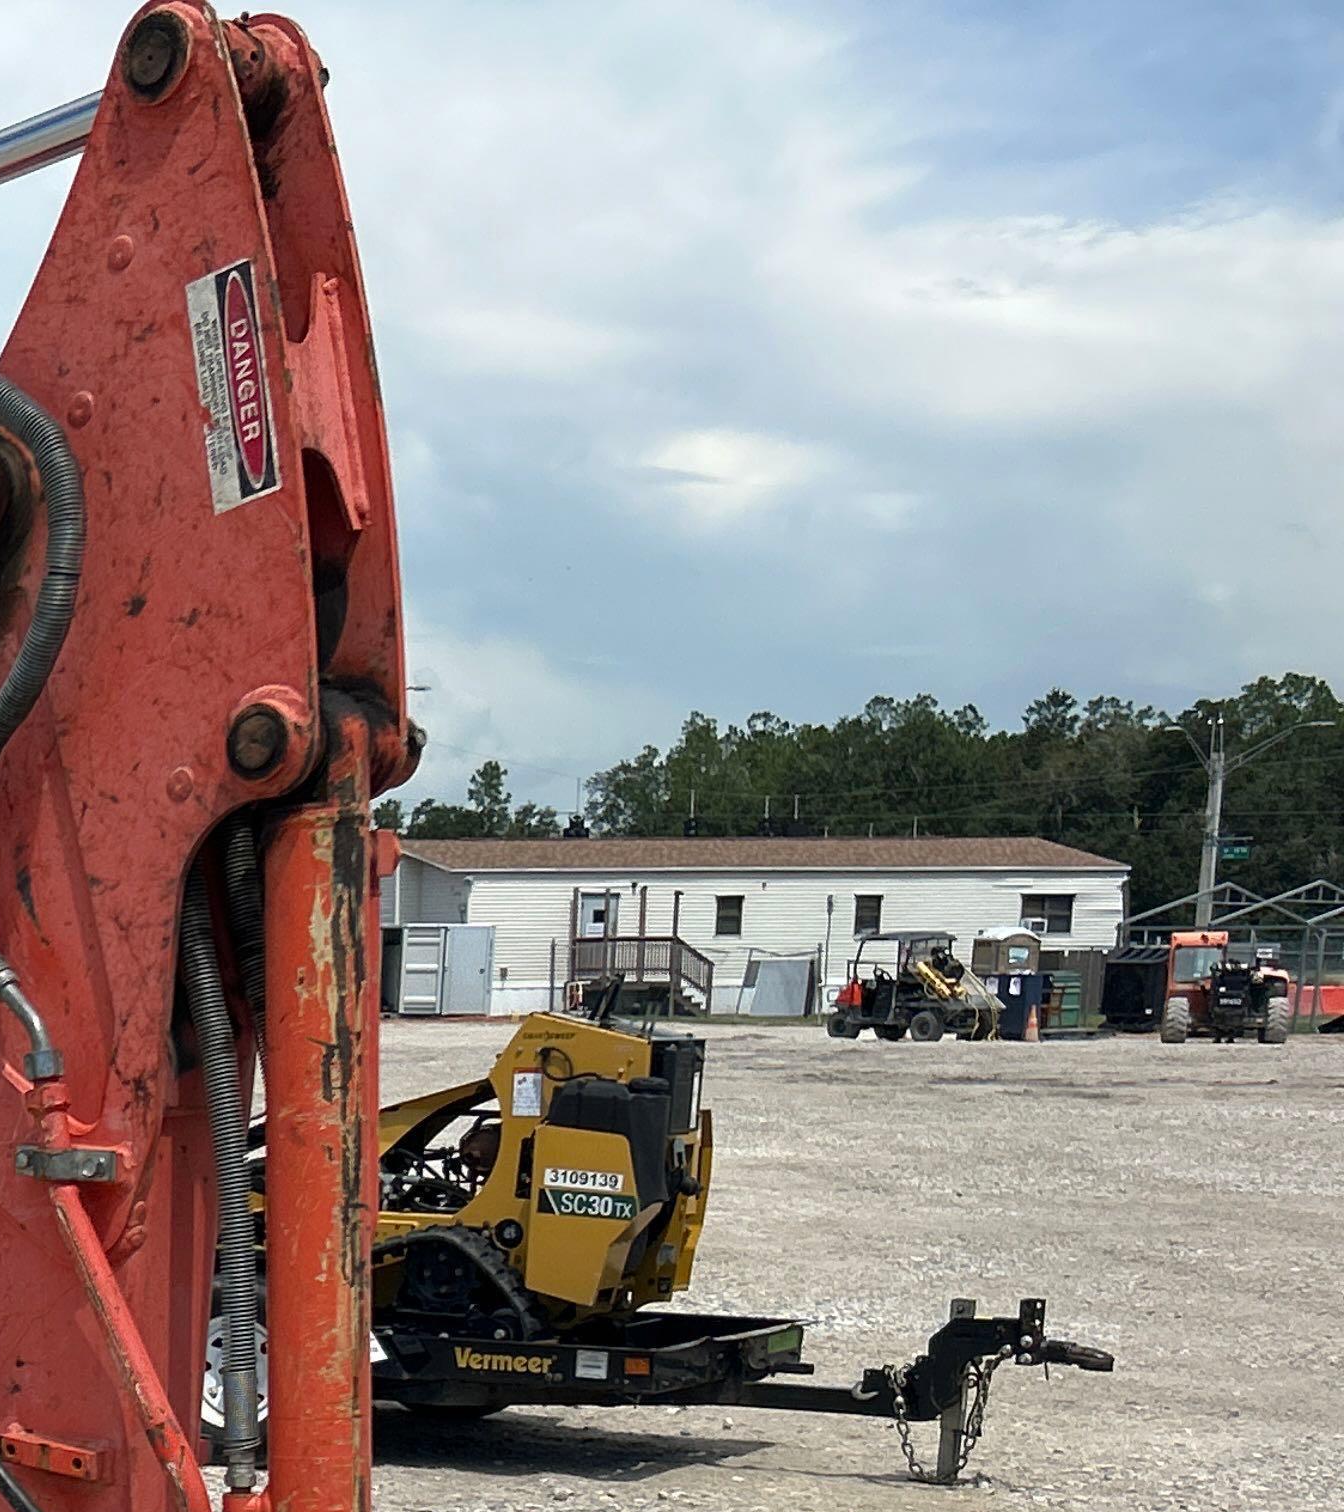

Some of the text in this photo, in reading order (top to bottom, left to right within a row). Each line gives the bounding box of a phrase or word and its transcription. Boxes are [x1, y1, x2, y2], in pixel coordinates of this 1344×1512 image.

[229, 318, 260, 443] DANGER
[549, 1170, 619, 1188] 3109139
[454, 1346, 553, 1373] Vermeer
